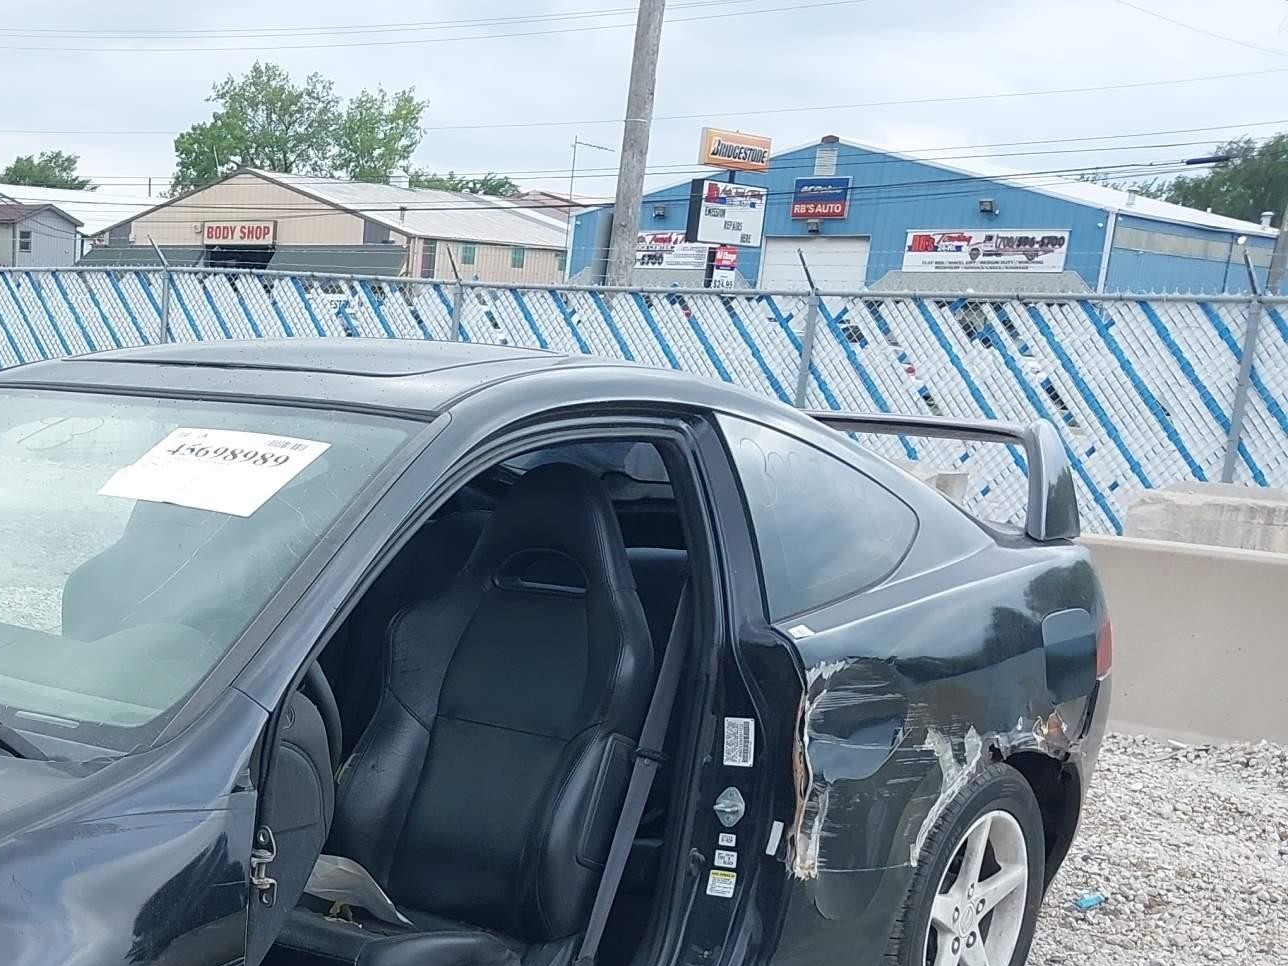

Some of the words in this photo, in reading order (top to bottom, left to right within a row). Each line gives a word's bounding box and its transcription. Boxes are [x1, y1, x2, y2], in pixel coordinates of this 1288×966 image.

[711, 139, 768, 164] BRIDGESTONE
[704, 207, 726, 218] EMISSION
[793, 203, 815, 213] RB'S
[815, 203, 842, 213] AUTO
[723, 220, 743, 231] REPAIRS
[206, 226, 236, 240] BODY
[239, 226, 270, 240] SHOP
[739, 233, 752, 244] HERE
[166, 443, 290, 467] 45698989
